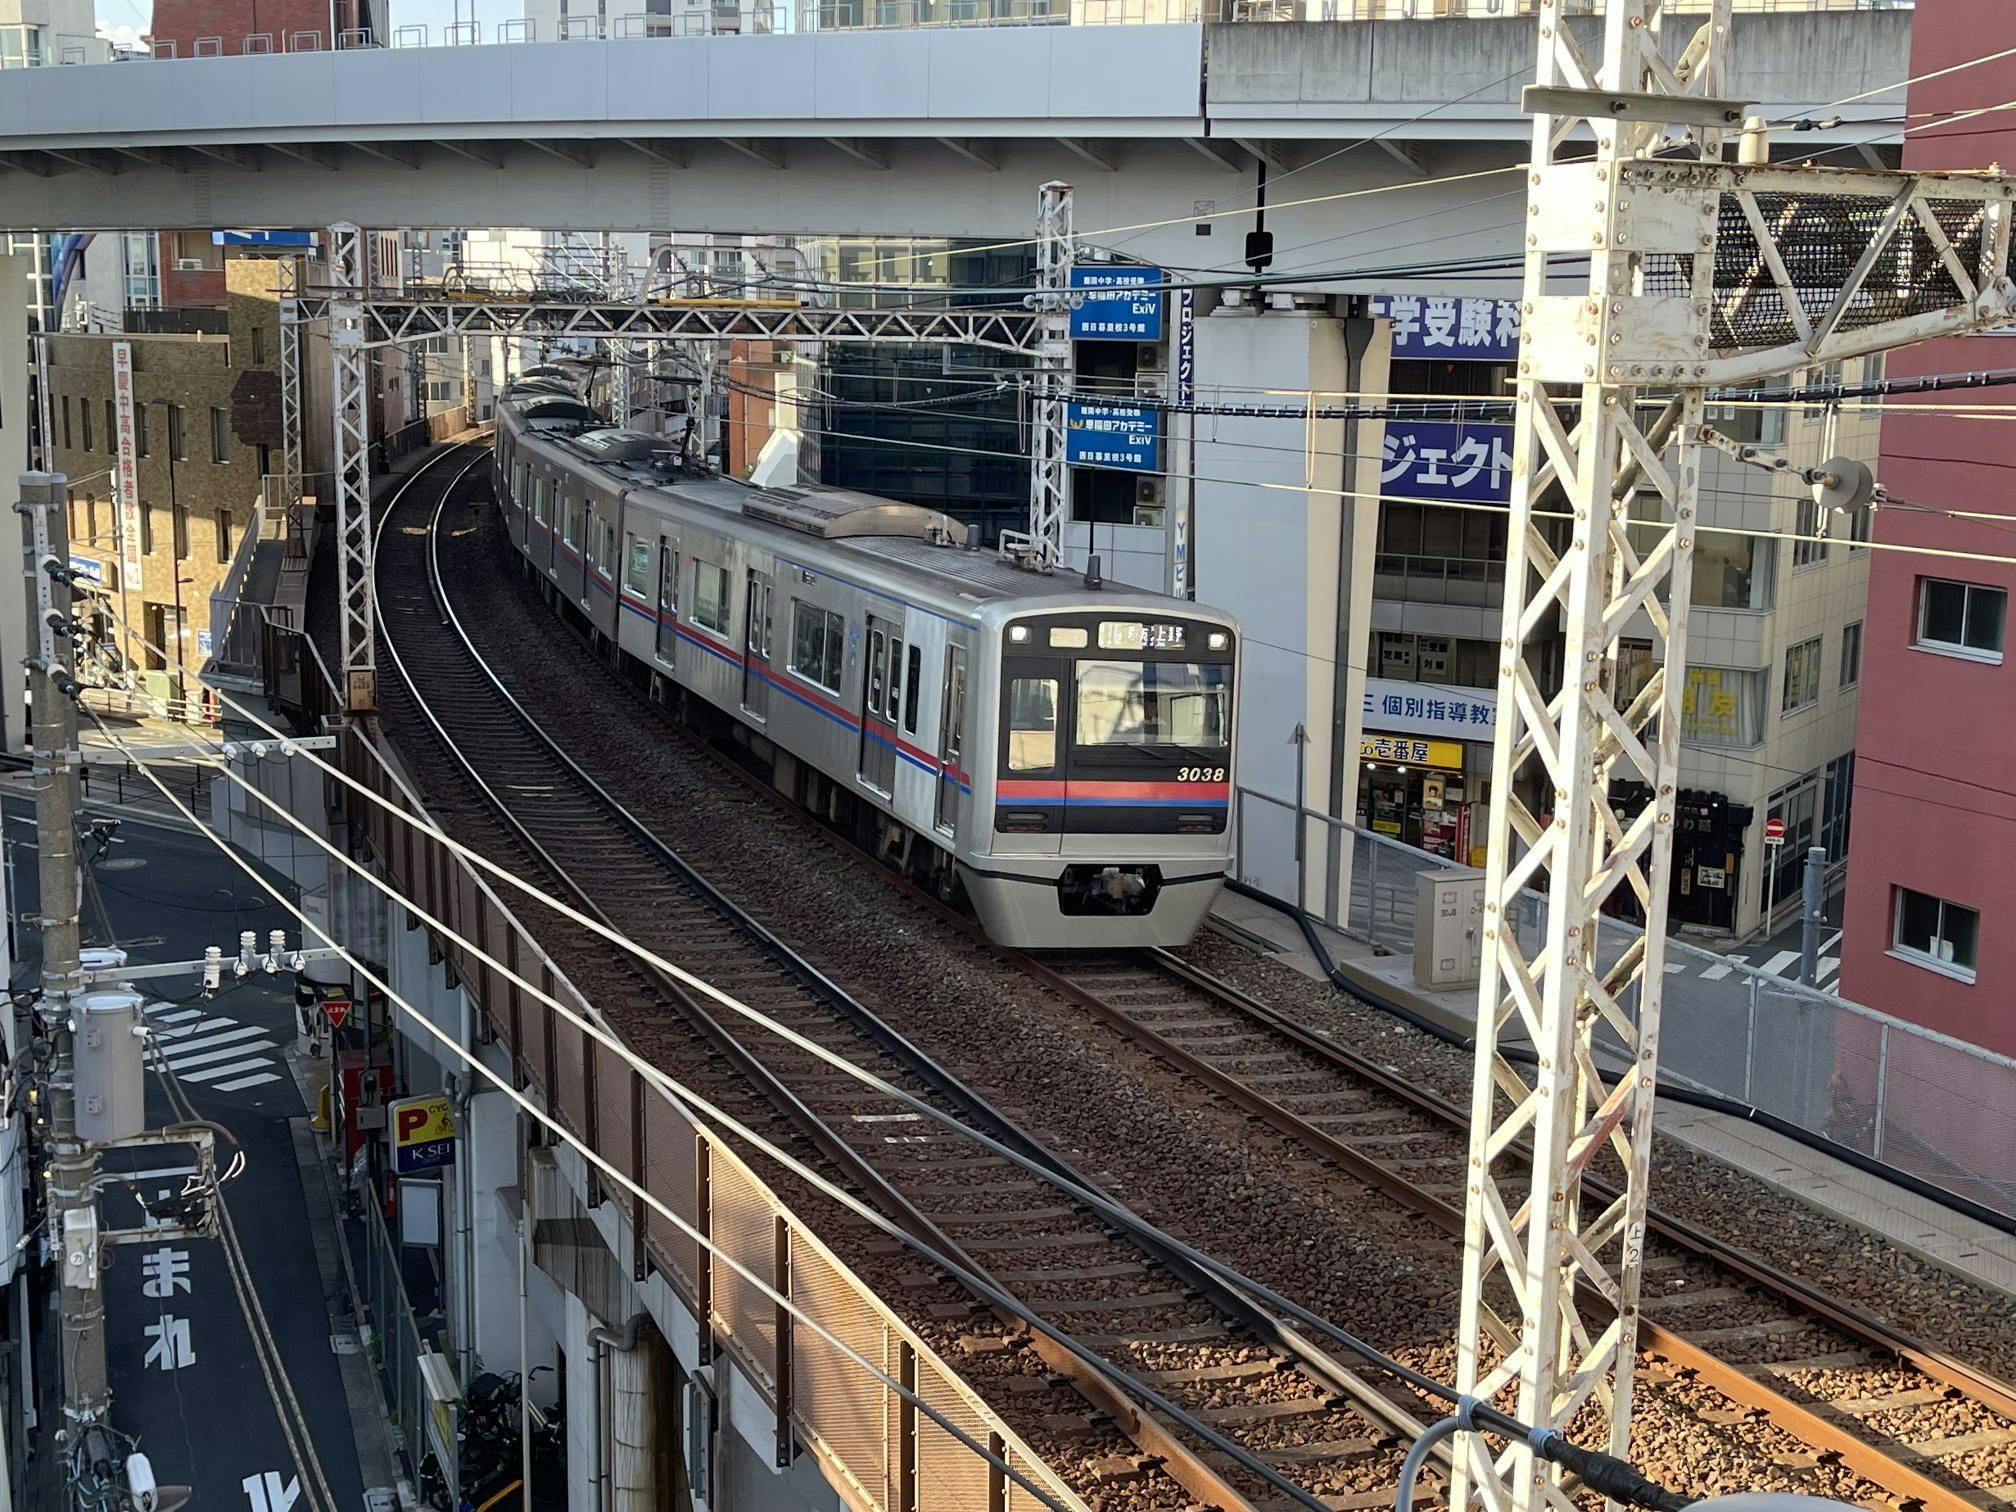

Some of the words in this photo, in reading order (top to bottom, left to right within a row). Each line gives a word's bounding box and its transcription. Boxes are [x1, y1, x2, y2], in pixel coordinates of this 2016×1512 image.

[1085, 419, 1152, 432] 早稲田アカデミー
[1177, 767, 1225, 782] 3038
[398, 1108, 428, 1142] P
